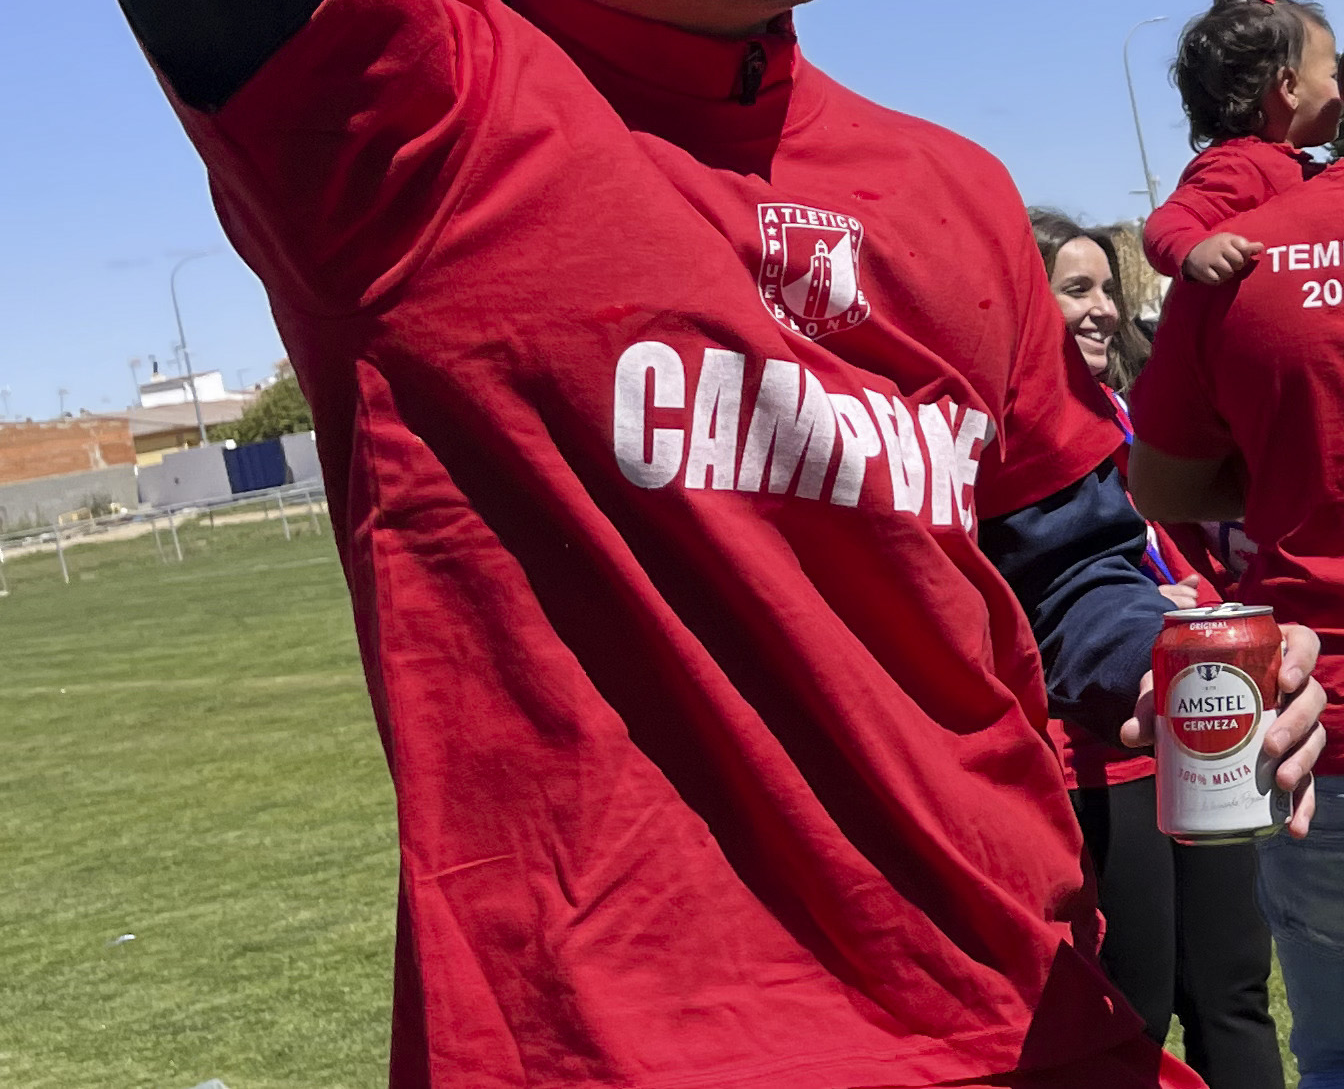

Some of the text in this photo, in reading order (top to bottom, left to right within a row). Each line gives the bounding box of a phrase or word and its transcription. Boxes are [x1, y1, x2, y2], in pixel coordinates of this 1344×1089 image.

[764, 208, 860, 231] ATLETICO
[1189, 621, 1229, 631] ORIGINAL
[1177, 695, 1246, 714] AMSTEL
[1183, 719, 1239, 731] CERVEZA
[1212, 764, 1252, 785] MALTA
